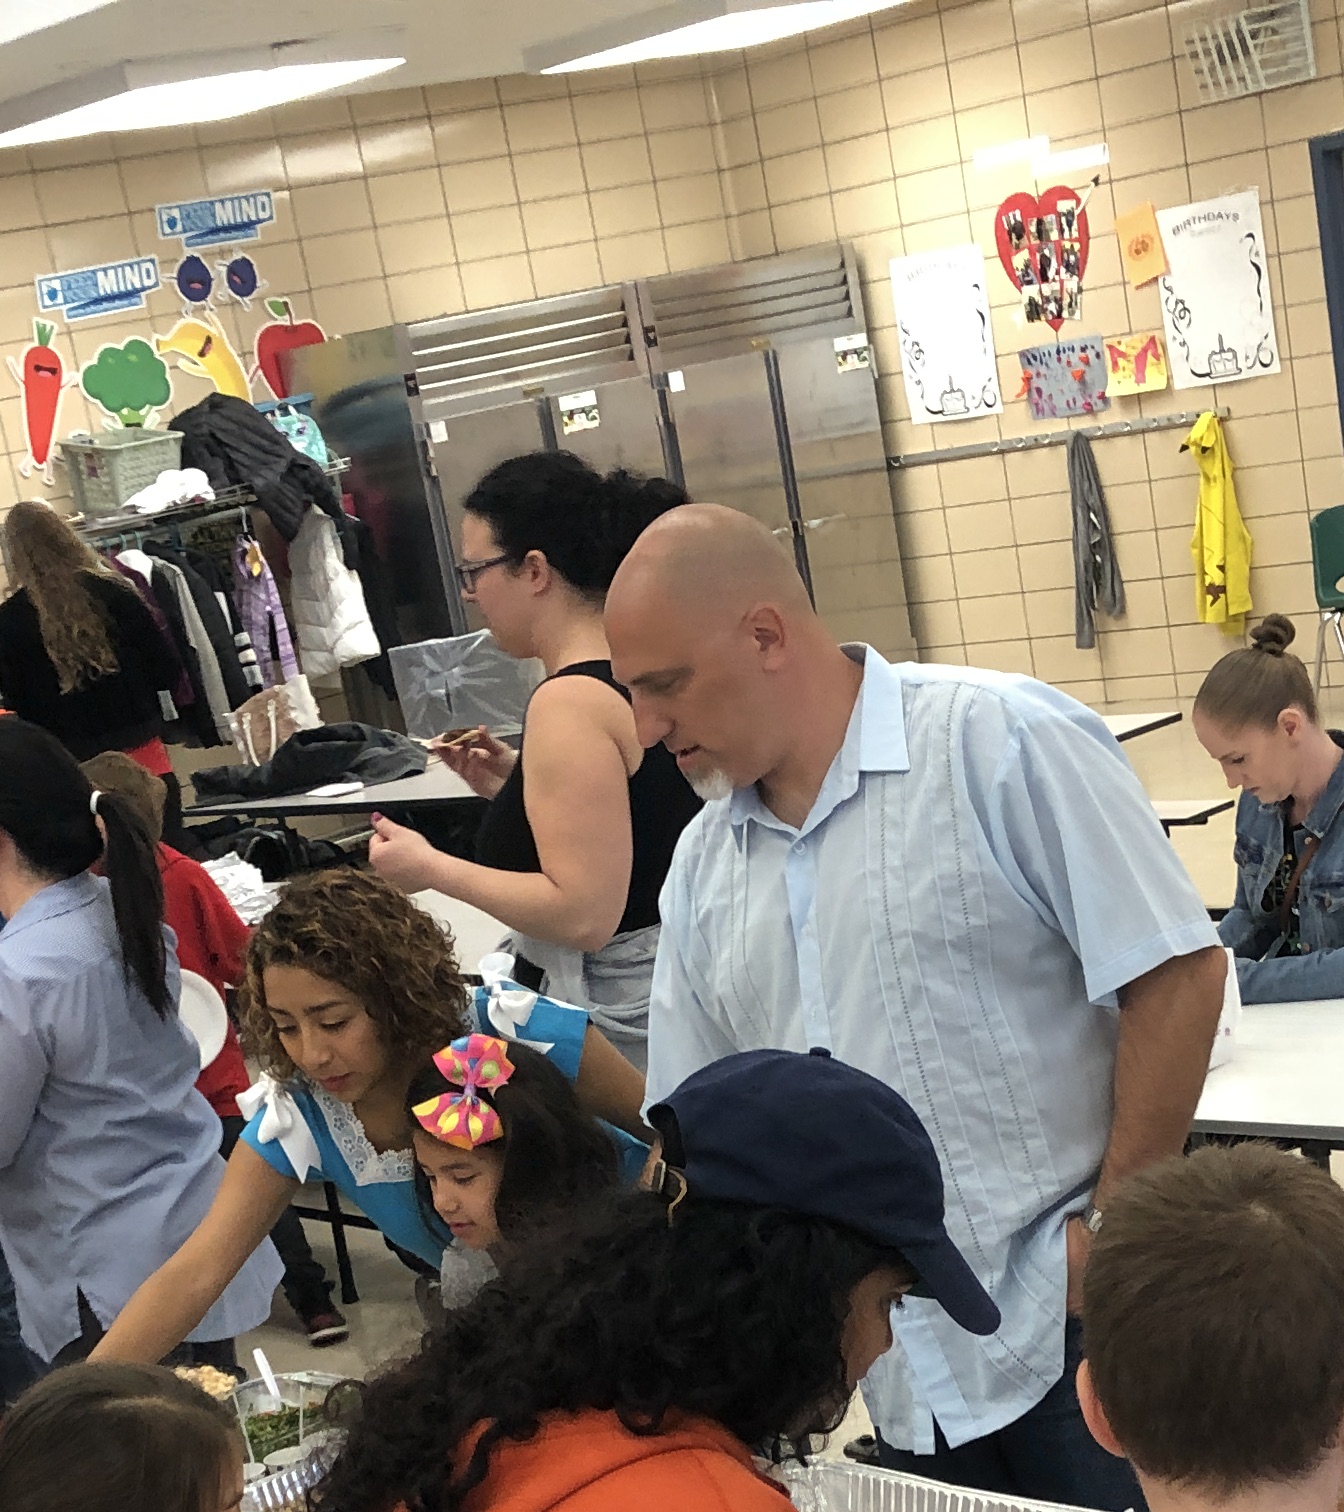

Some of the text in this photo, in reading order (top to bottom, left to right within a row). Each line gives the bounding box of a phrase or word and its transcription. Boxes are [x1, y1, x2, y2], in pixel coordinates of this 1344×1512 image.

[214, 194, 273, 226] MIND
[1172, 210, 1240, 236] BIRTHDAYS
[95, 260, 157, 296] MIND
